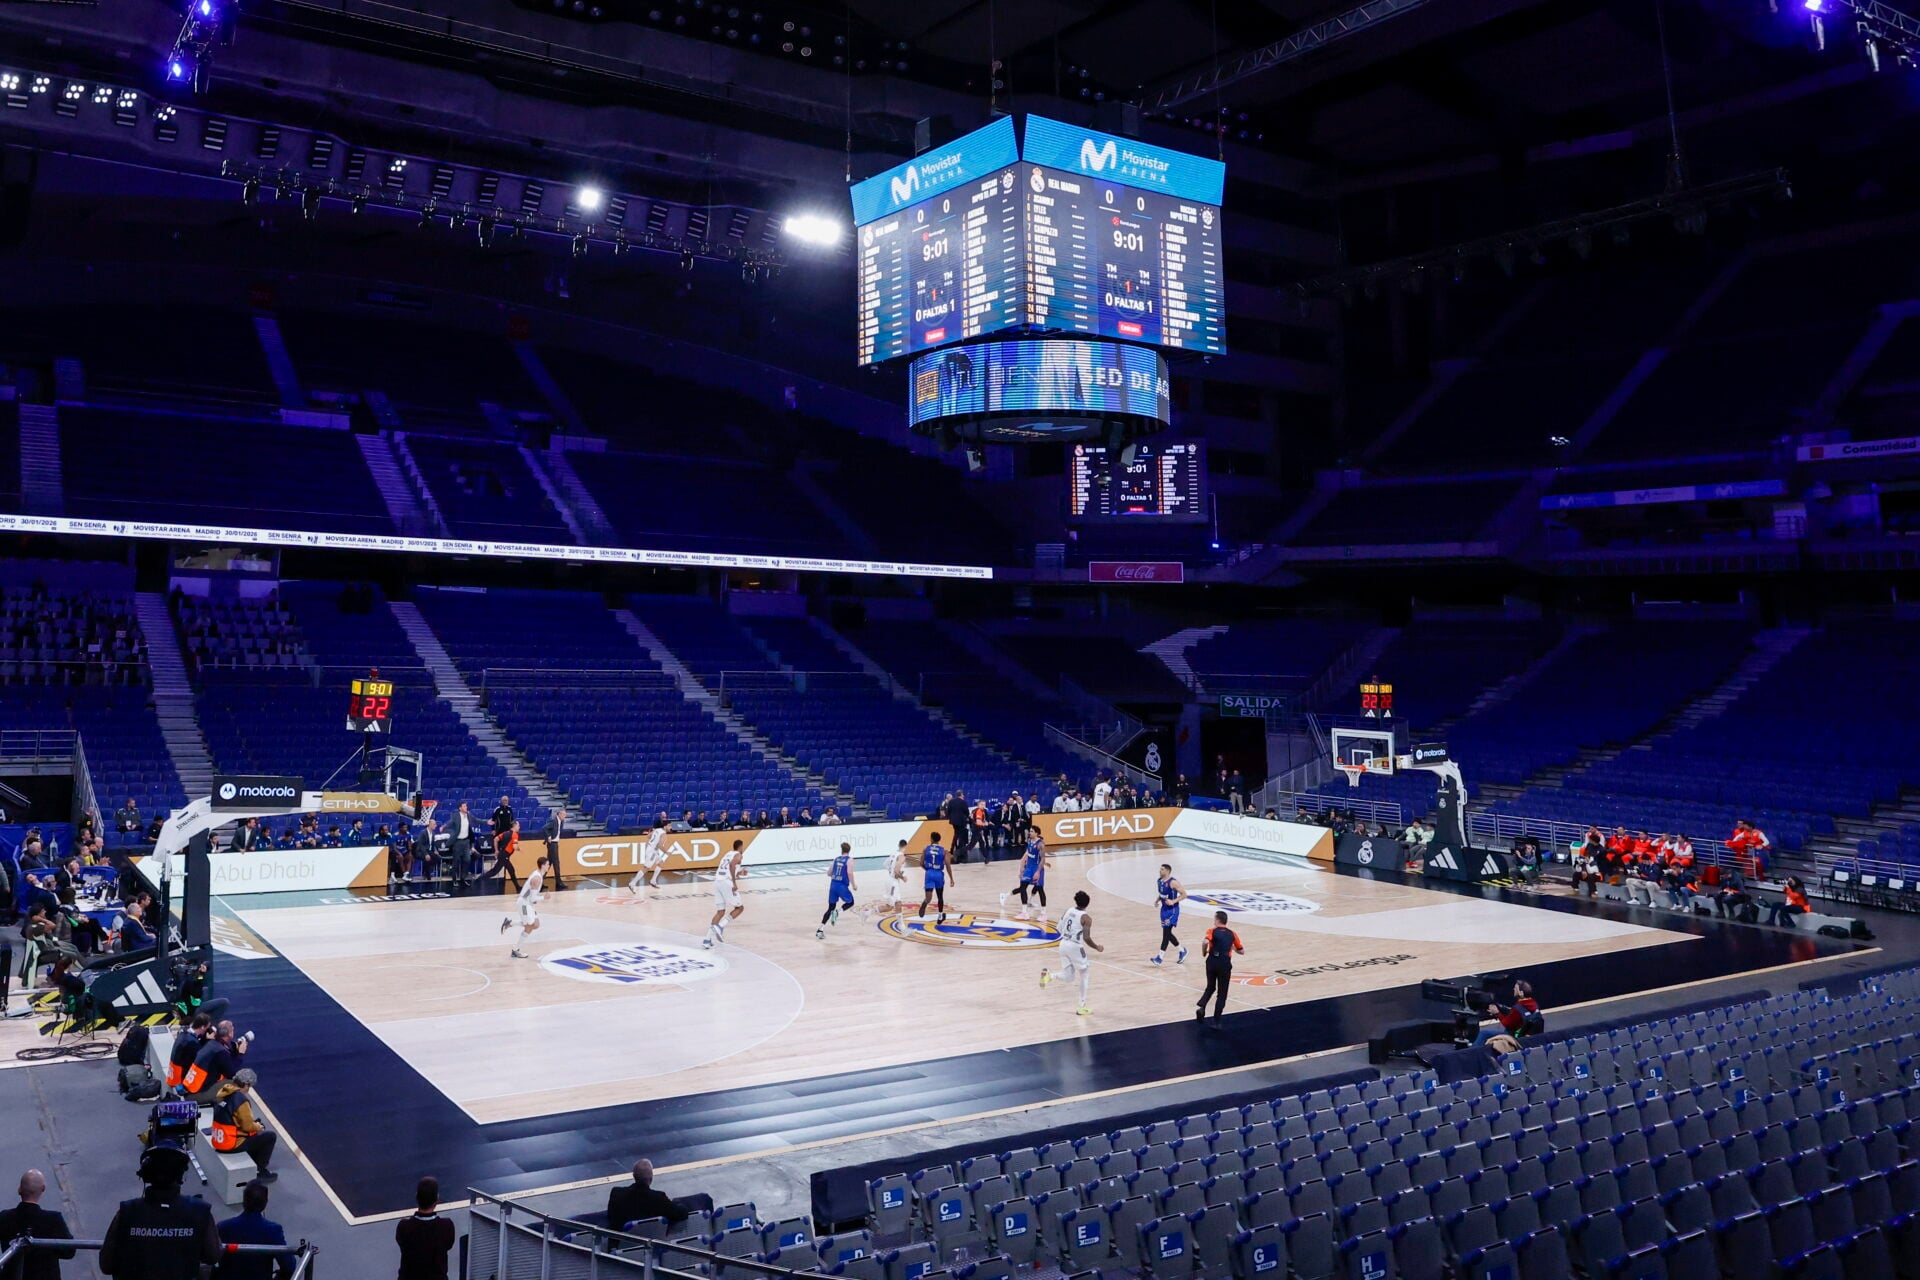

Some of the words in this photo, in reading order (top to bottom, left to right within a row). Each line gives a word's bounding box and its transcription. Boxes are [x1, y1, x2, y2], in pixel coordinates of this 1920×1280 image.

[922, 152, 962, 177] Movistar
[1122, 150, 1170, 172] Movistar
[924, 166, 964, 189] ARENA
[1122, 166, 1167, 184] ARENA
[1106, 190, 1114, 204] 0
[943, 199, 950, 214] 0
[1137, 197, 1145, 212] 0
[917, 210, 924, 223] 0
[1113, 230, 1144, 252] 9:01
[923, 238, 948, 262] 9:01
[1106, 264, 1118, 272] TM
[944, 271, 952, 280] TM
[1139, 270, 1150, 280] TM
[916, 280, 926, 288] TM
[1124, 281, 1132, 294] 1
[932, 288, 936, 302] 1
[1106, 292, 1112, 306] 0
[1114, 296, 1144, 311] FALTAS
[1148, 300, 1152, 314] 1
[916, 310, 922, 322] 0
[922, 304, 948, 319] FALTAS
[950, 299, 954, 312] 1
[1842, 440, 1917, 454] Comunidad
[1127, 464, 1148, 474] 9:01
[20, 518, 57, 526] 30/01/2026
[370, 683, 392, 694] 9:01
[363, 698, 389, 718] 22
[1224, 696, 1283, 708] SALIDA
[1362, 694, 1378, 709] 22
[1240, 708, 1266, 716] EXIT
[1424, 748, 1446, 758] motorola
[239, 786, 296, 798] motorola
[322, 800, 380, 808] ETIHAD
[1055, 814, 1154, 838] ETIHAD
[1203, 822, 1220, 834] via
[1222, 822, 1245, 838] Abu
[1249, 826, 1284, 842] Dhabi
[786, 837, 805, 851] via
[808, 836, 836, 850] Abu
[840, 832, 878, 848] Dhabi
[214, 864, 252, 882] Abu
[259, 861, 315, 880] Dhabi
[320, 892, 451, 904] Emirates
[1066, 919, 1072, 932] 8
[1275, 954, 1417, 976] EuroLeague
[1576, 1066, 1582, 1074] C
[1730, 1069, 1736, 1078] E
[1817, 1069, 1822, 1080] F
[1914, 1069, 1920, 1080] G
[1840, 1090, 1846, 1102] G
[884, 1192, 892, 1202] B
[940, 1203, 948, 1215] C
[742, 1218, 750, 1228] B
[1006, 1217, 1014, 1230] D
[130, 1227, 194, 1238] BROADCASTERS
[795, 1233, 804, 1245] C
[1078, 1226, 1086, 1240] E
[1160, 1236, 1168, 1250] F
[1254, 1248, 1264, 1264] G
[922, 1262, 930, 1274] E
[1362, 1256, 1373, 1272] H
